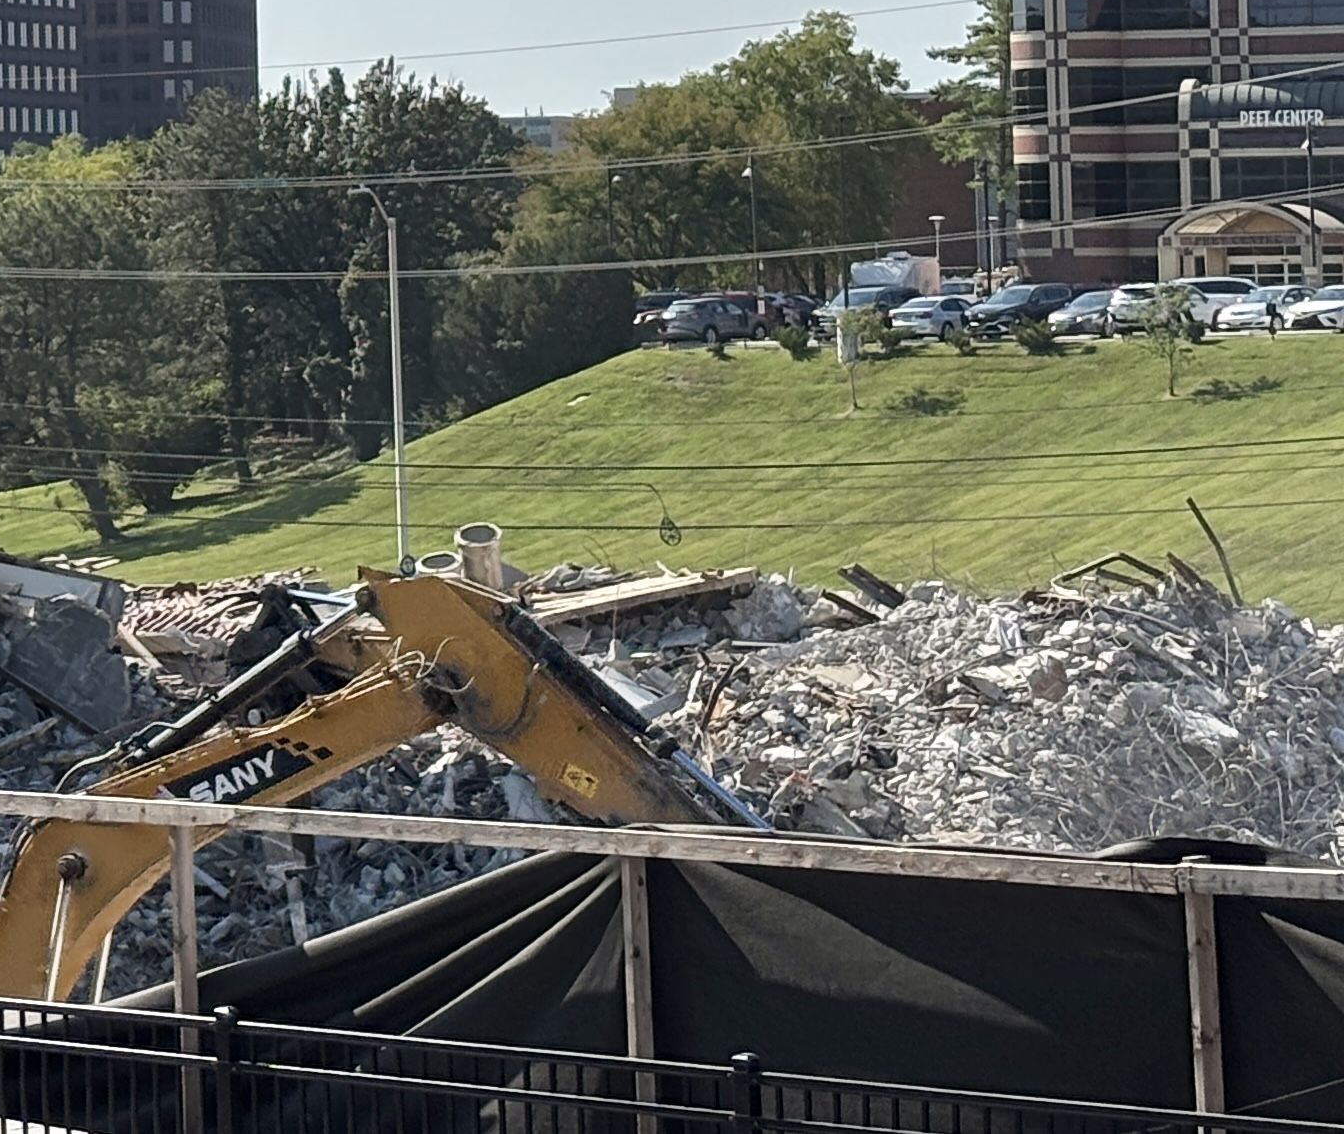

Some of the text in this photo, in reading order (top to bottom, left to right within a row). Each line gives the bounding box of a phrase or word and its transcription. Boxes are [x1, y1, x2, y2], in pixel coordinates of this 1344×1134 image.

[1240, 109, 1324, 127] PEET CENTER
[189, 749, 275, 803] SANY
